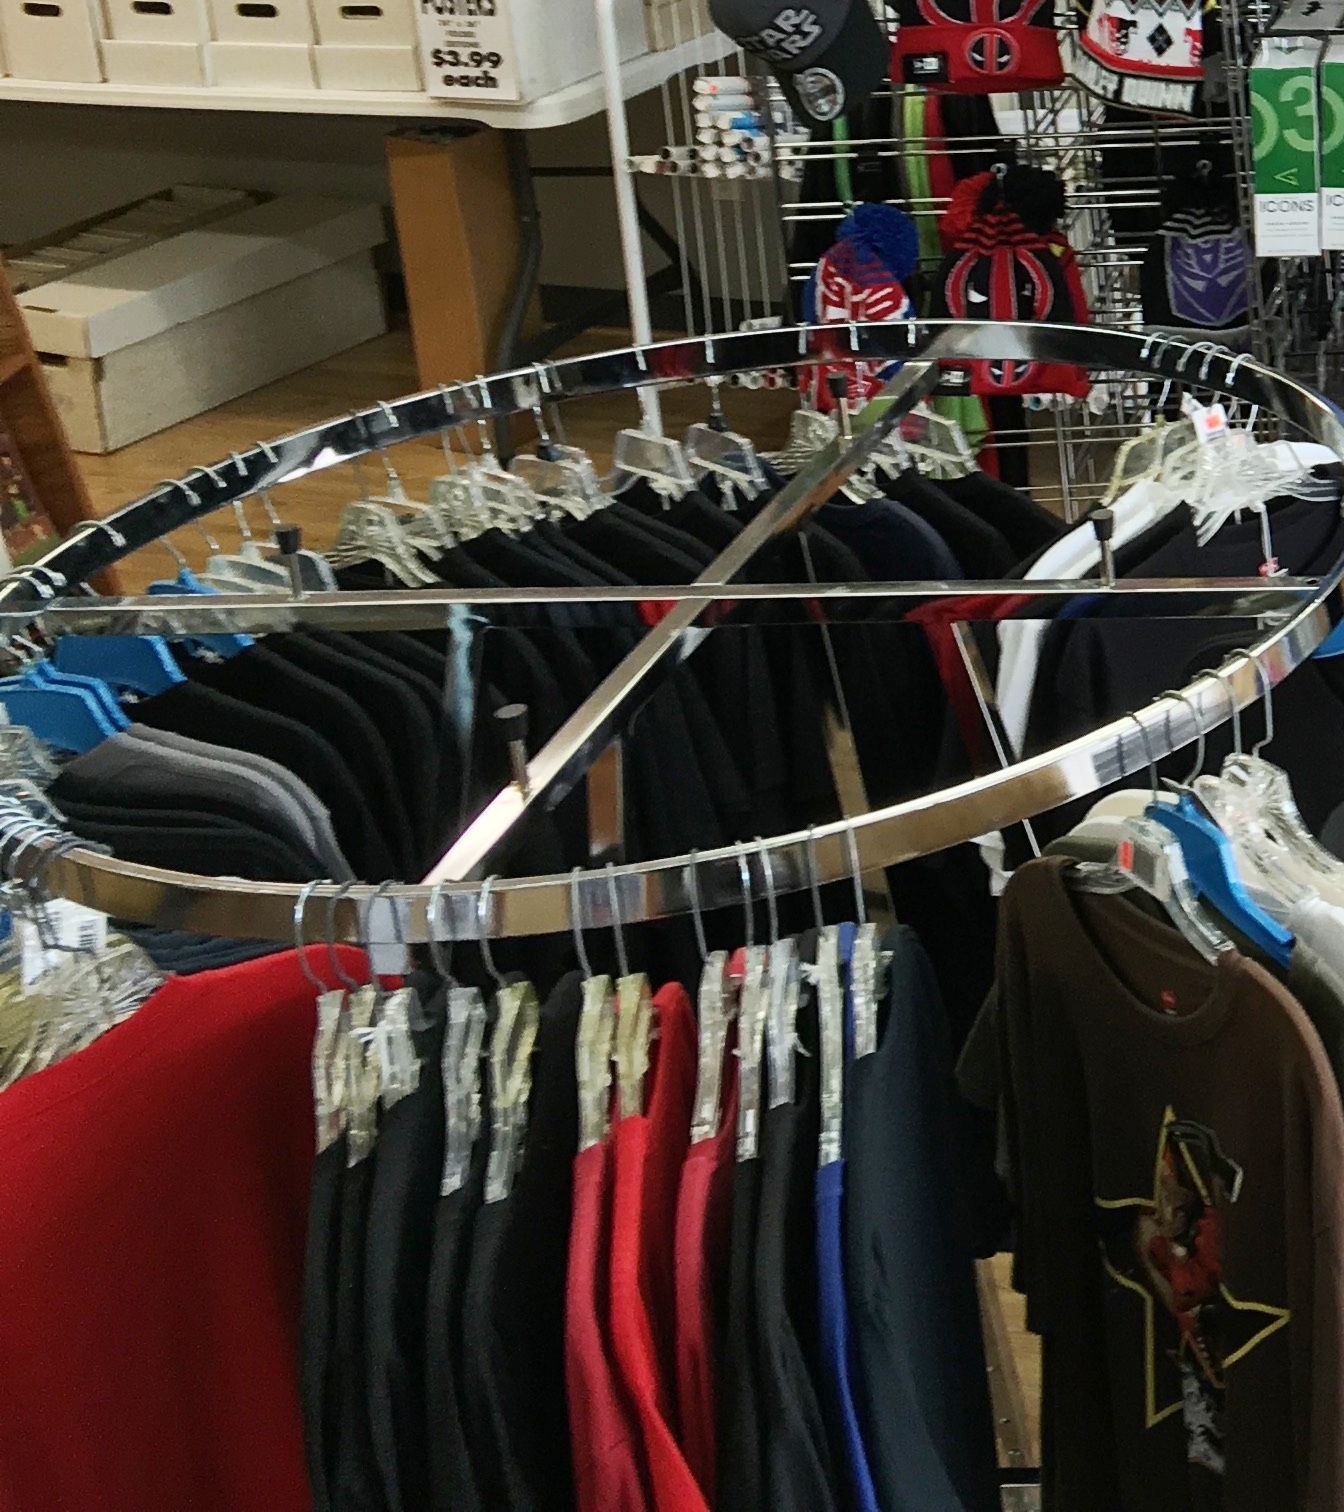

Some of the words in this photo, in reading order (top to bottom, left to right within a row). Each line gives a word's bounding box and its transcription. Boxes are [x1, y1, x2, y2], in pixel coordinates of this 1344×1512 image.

[431, 49, 503, 68] $3.99
[443, 70, 498, 88] each
[1260, 199, 1315, 213] ICONS
